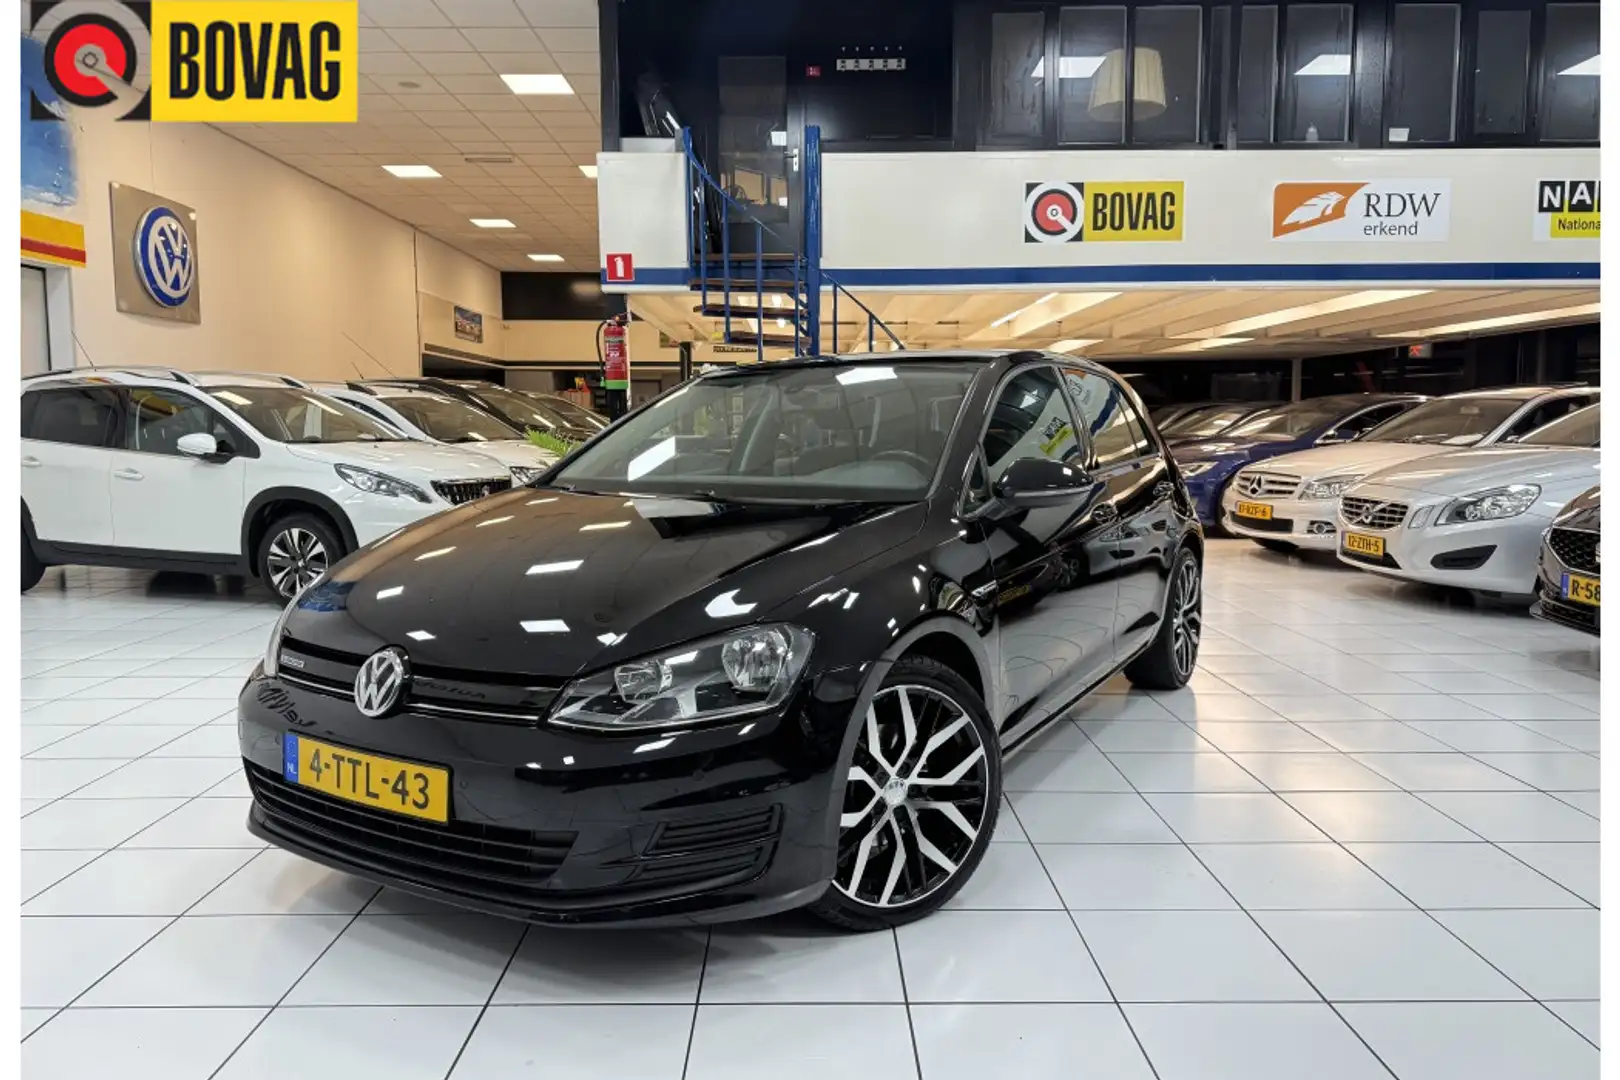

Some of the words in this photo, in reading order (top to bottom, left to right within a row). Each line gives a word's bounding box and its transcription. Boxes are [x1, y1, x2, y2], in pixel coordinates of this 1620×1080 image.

[1091, 191, 1176, 231] BOVAG
[1363, 192, 1441, 217] RDW
[1363, 220, 1418, 237] erkend
[308, 748, 430, 811] 4-TTL-43
